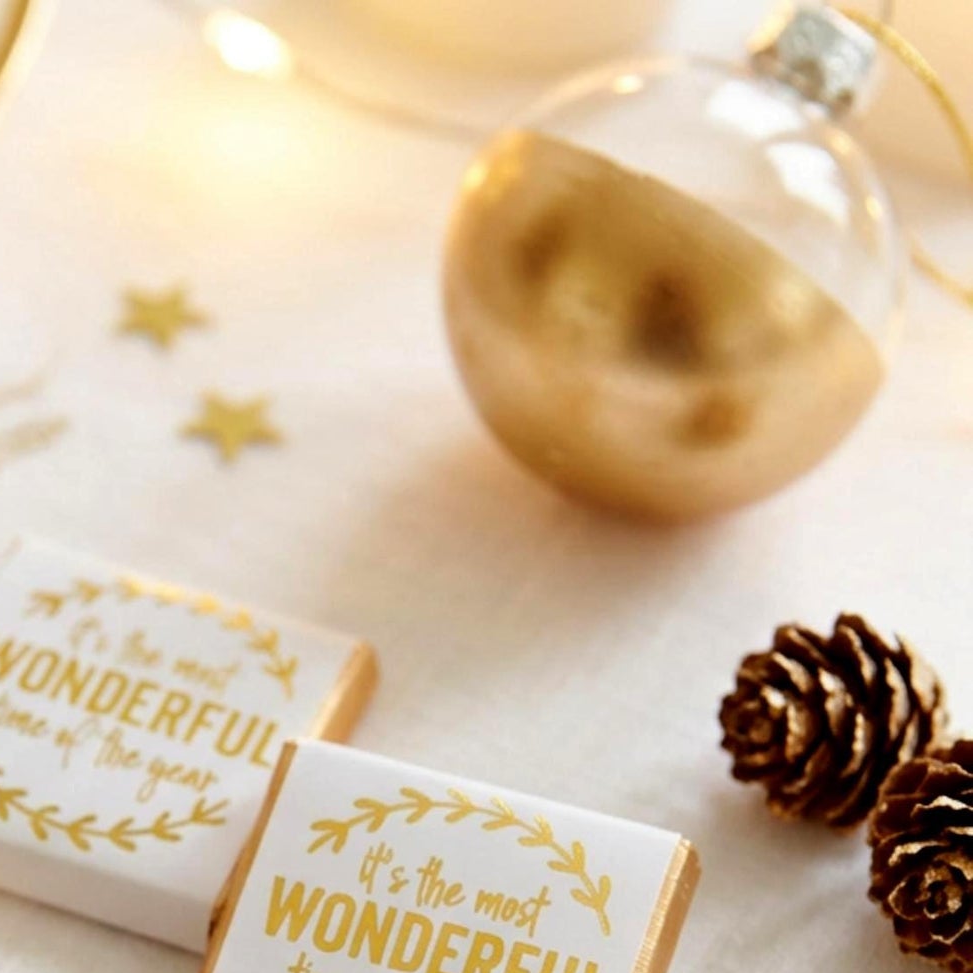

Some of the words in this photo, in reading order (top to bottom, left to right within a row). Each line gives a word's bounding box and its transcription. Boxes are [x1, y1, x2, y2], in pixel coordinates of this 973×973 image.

[119, 630, 163, 666] the
[54, 716, 102, 769] of
[94, 727, 142, 768] the
[137, 755, 219, 804] year
[358, 842, 410, 895] it's
[416, 856, 467, 908] the
[473, 886, 551, 937] most
